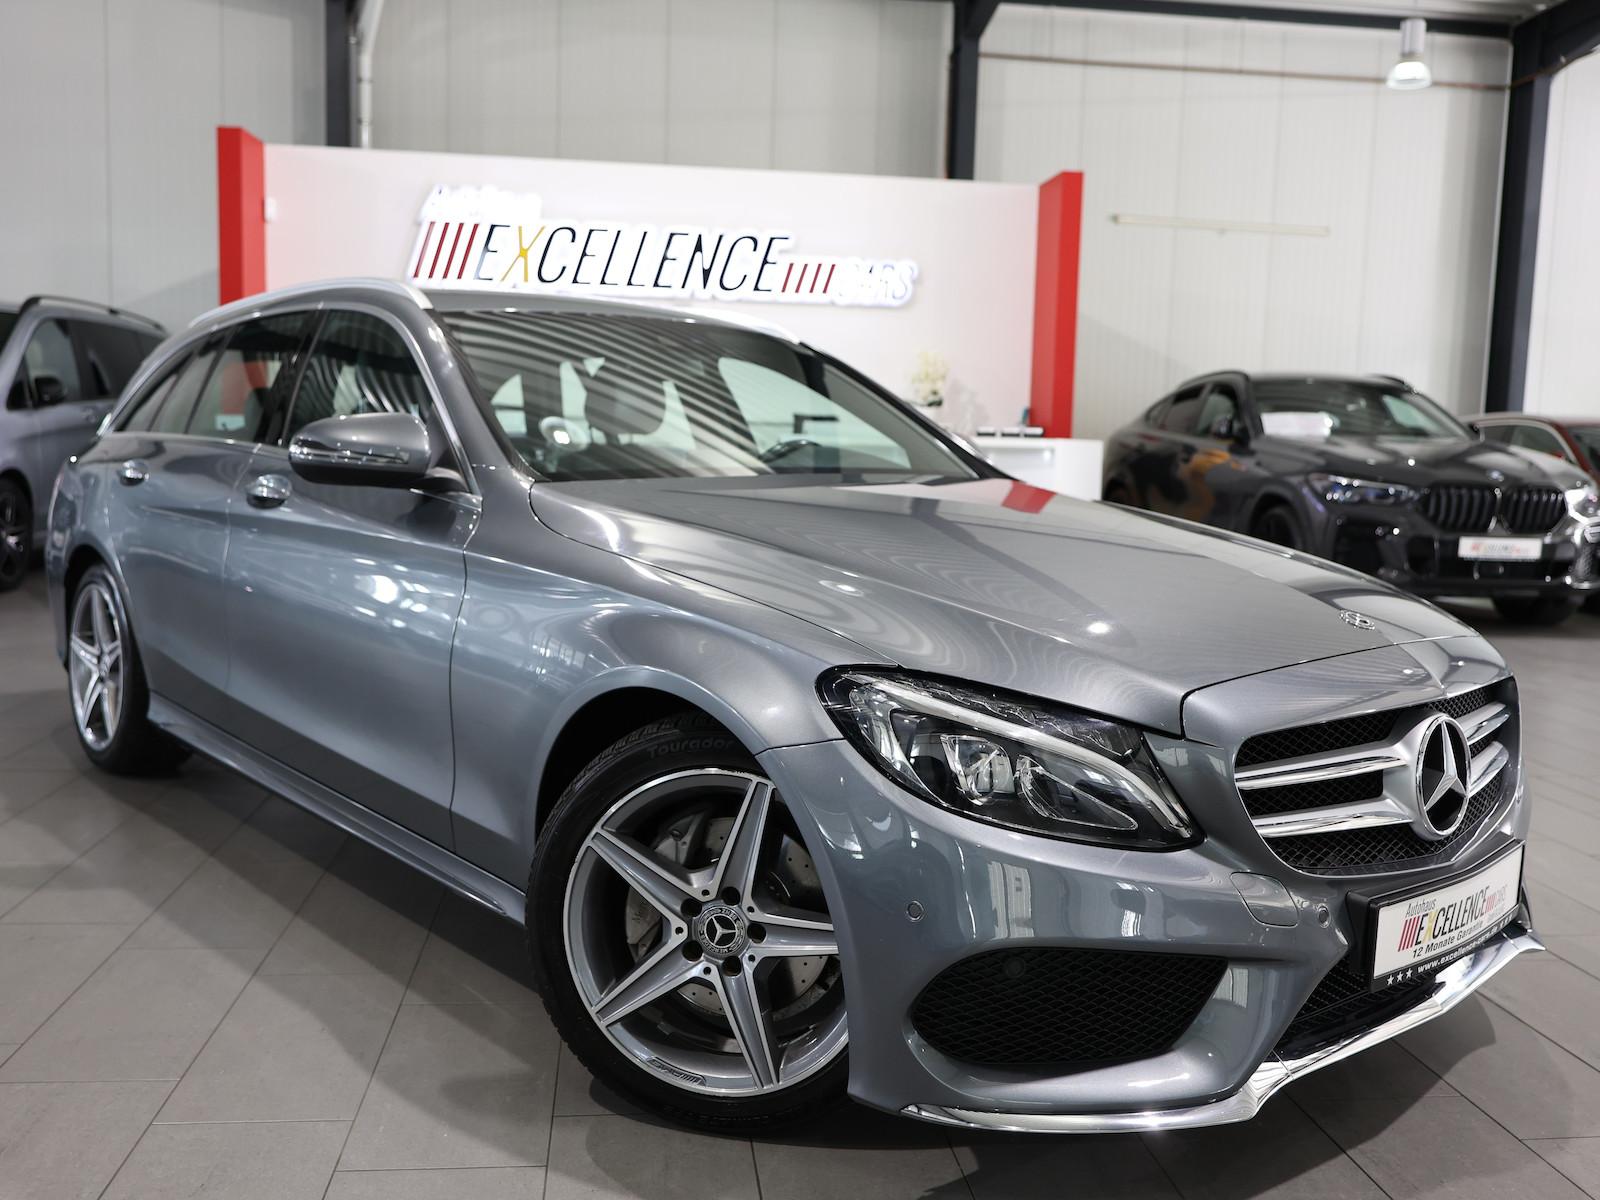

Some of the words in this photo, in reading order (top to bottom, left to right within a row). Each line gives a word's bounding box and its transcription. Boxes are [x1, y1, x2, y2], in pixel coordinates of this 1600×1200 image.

[475, 224, 790, 292] EXCELLENCE
[646, 737, 734, 758] Tourador
[1405, 899, 1437, 917] Autohaus
[1415, 885, 1490, 946] EXCELLENCE
[1412, 946, 1423, 958] 12
[1425, 934, 1455, 953] Monate
